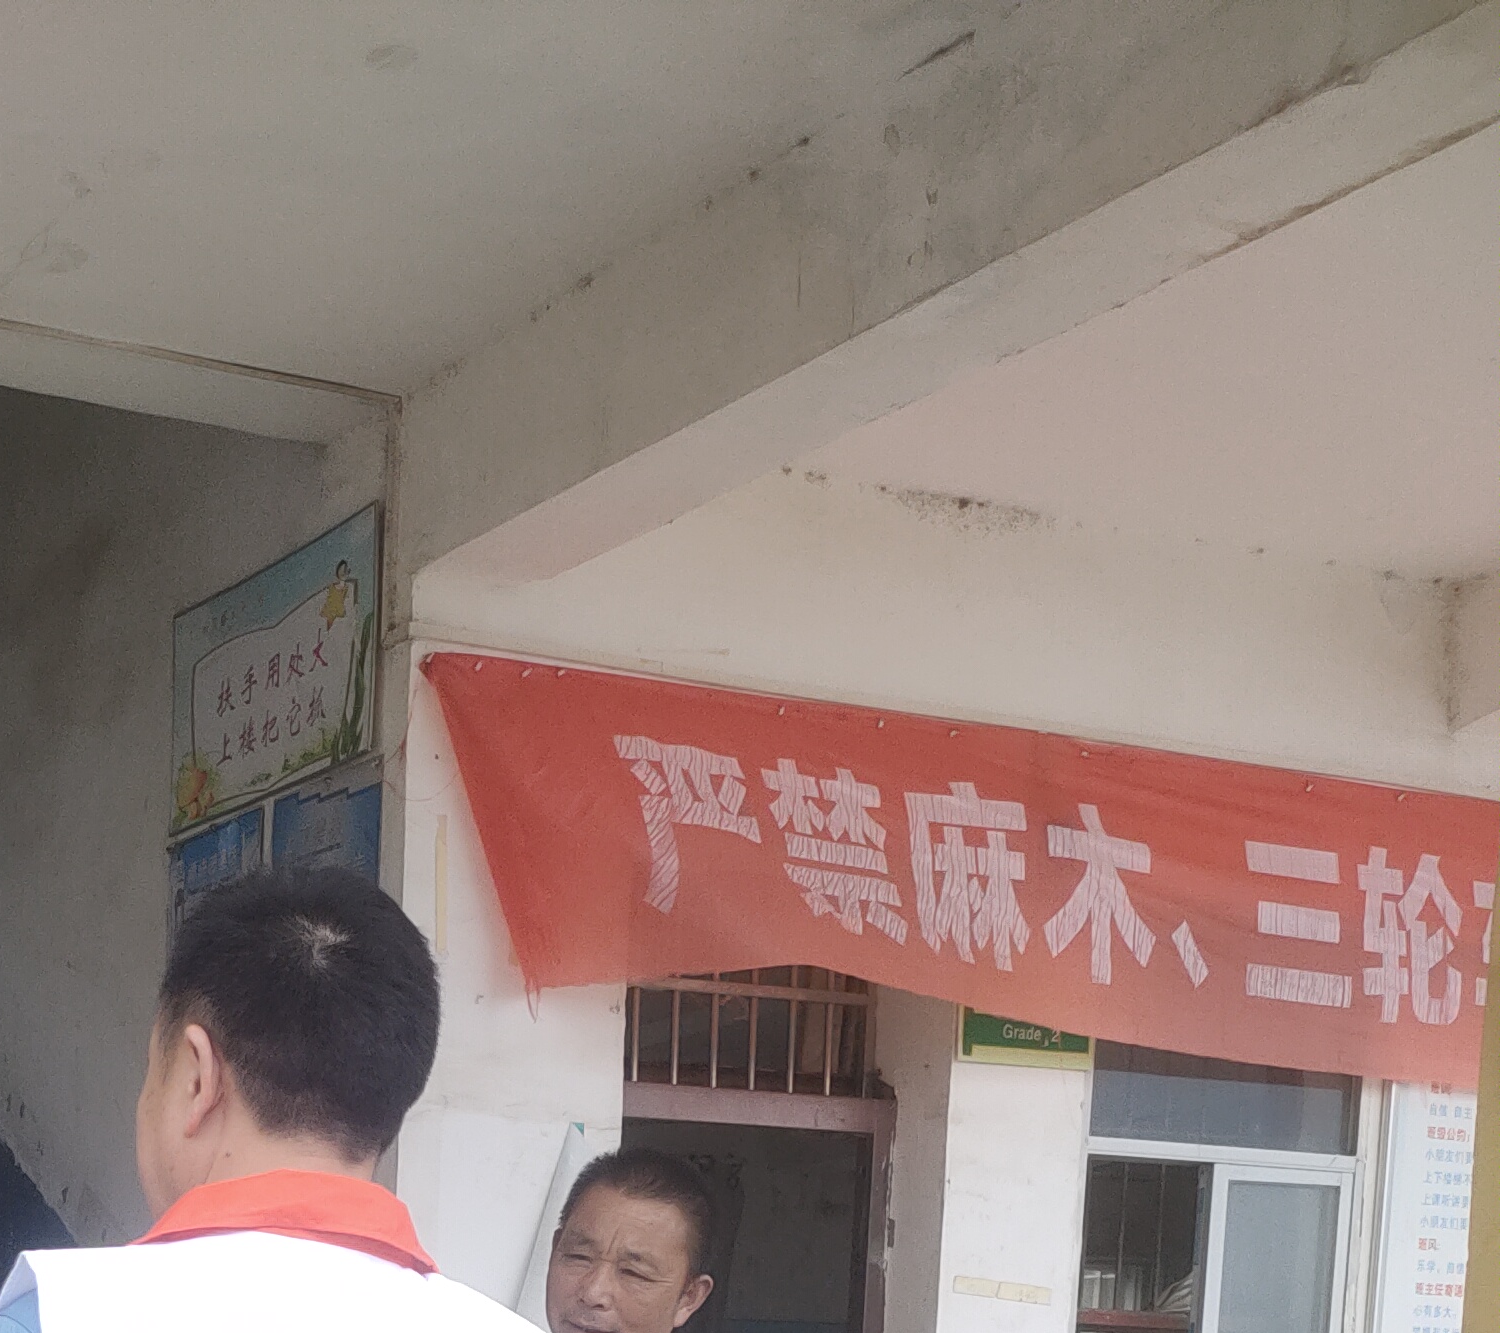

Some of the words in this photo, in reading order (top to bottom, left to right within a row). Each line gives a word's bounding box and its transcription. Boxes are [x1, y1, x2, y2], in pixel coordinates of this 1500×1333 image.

[216, 628, 328, 718] 扶手用处大
[612, 733, 1492, 1028] 严禁麻木、三轮
[1002, 1023, 1042, 1042] Grade
